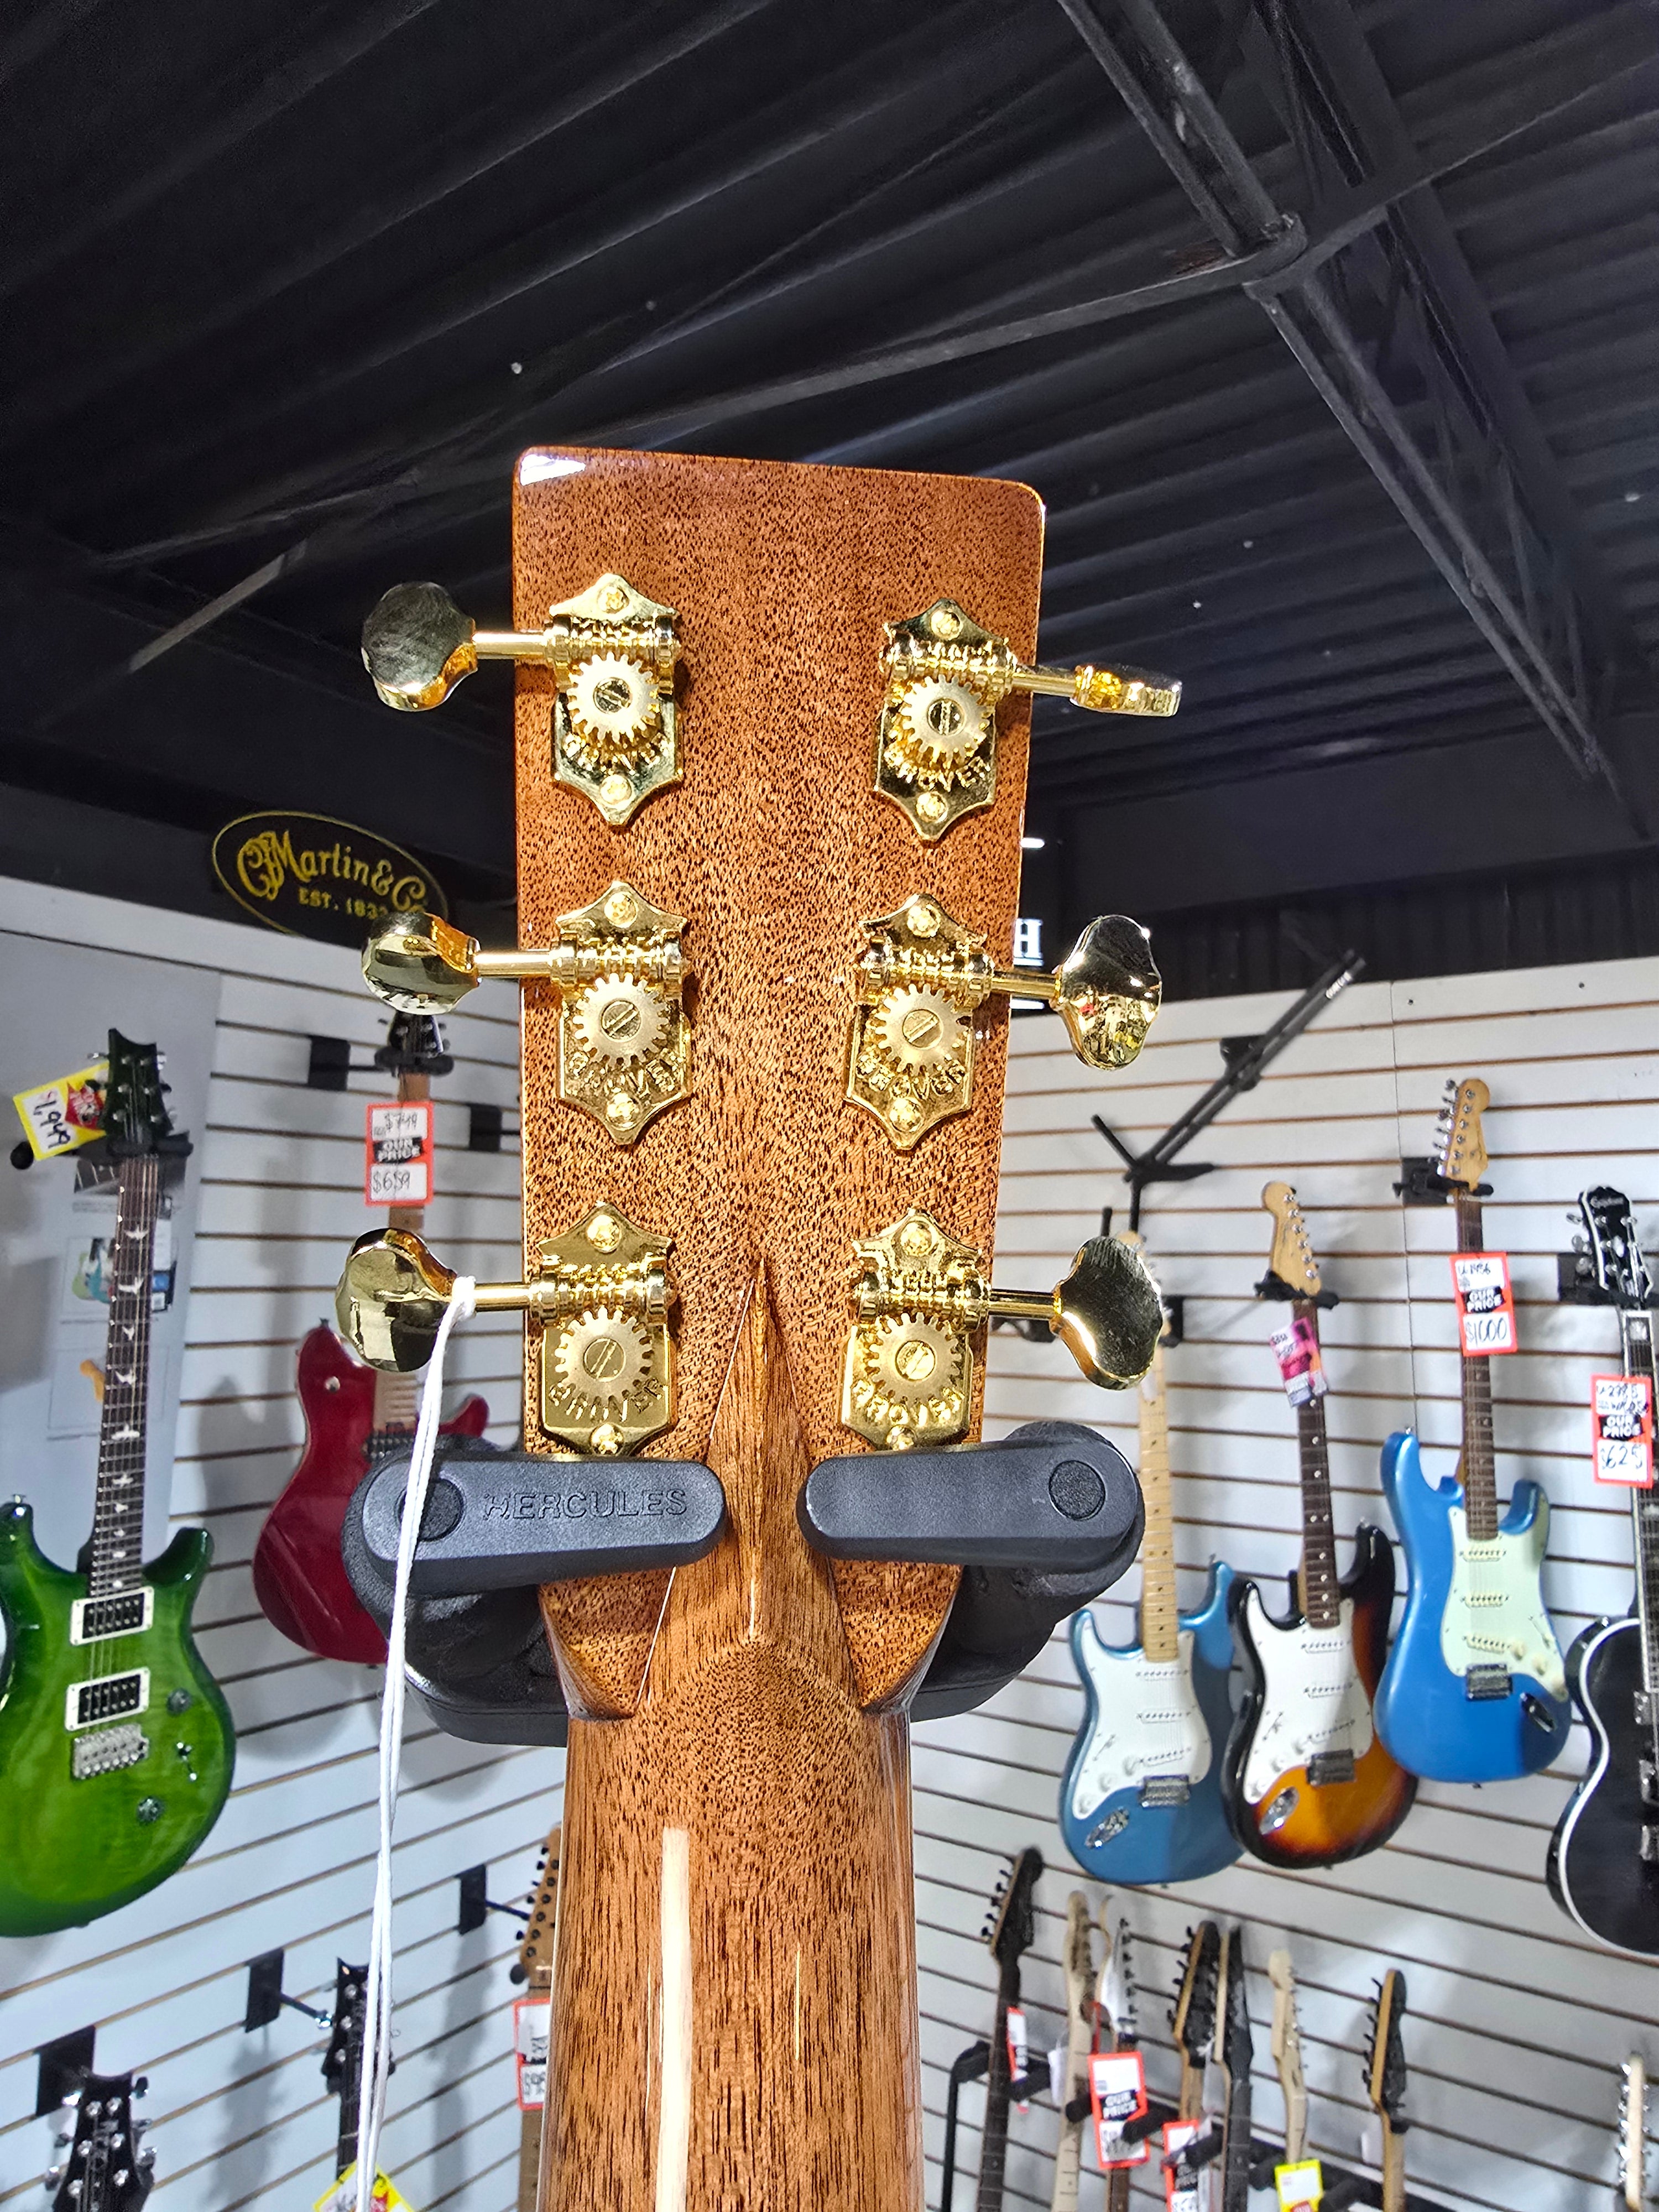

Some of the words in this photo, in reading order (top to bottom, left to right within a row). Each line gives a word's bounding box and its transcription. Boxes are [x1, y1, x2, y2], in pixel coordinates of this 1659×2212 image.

[378, 1146, 420, 1162] PRICE
[1469, 1288, 1495, 1302] OUR
[1467, 1294, 1503, 1313] PRICE
[1465, 1317, 1507, 1347] $1000
[1606, 1416, 1634, 1427] OUR
[1603, 1423, 1641, 1438] PRICE
[483, 1488, 688, 1521] HERCULES
